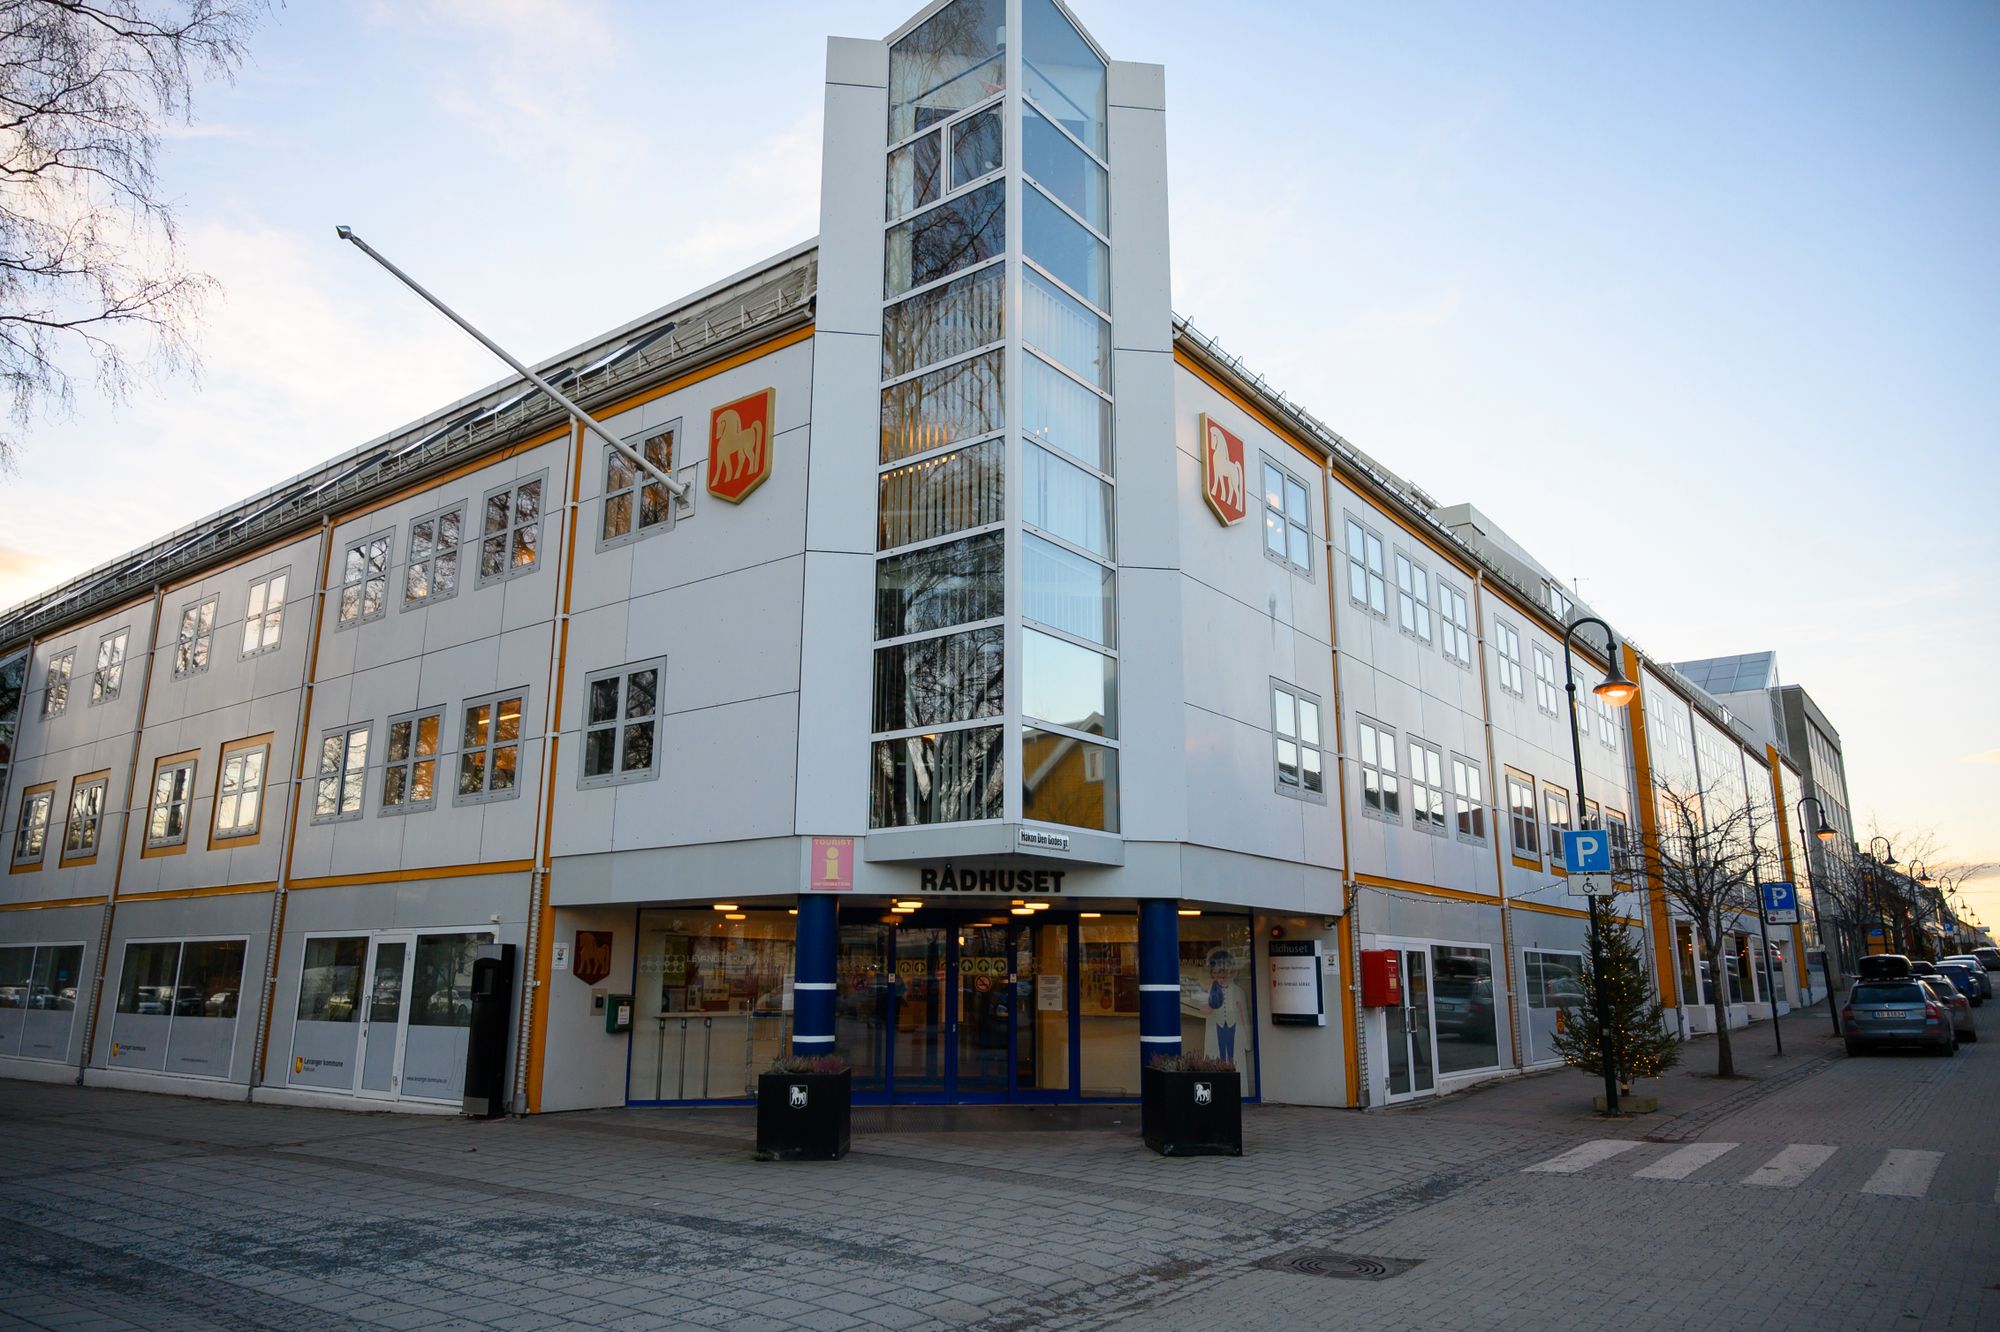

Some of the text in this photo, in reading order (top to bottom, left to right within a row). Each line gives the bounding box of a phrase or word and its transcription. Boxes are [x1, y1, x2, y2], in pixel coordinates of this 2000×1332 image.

[814, 838, 851, 846] TOURIST
[1037, 833, 1047, 844] Den
[1048, 835, 1062, 846] Godes
[1576, 836, 1599, 867] P
[921, 863, 1065, 893] RÅDHUSET
[1771, 887, 1787, 906] P
[304, 1057, 343, 1068] Levanger kommune
